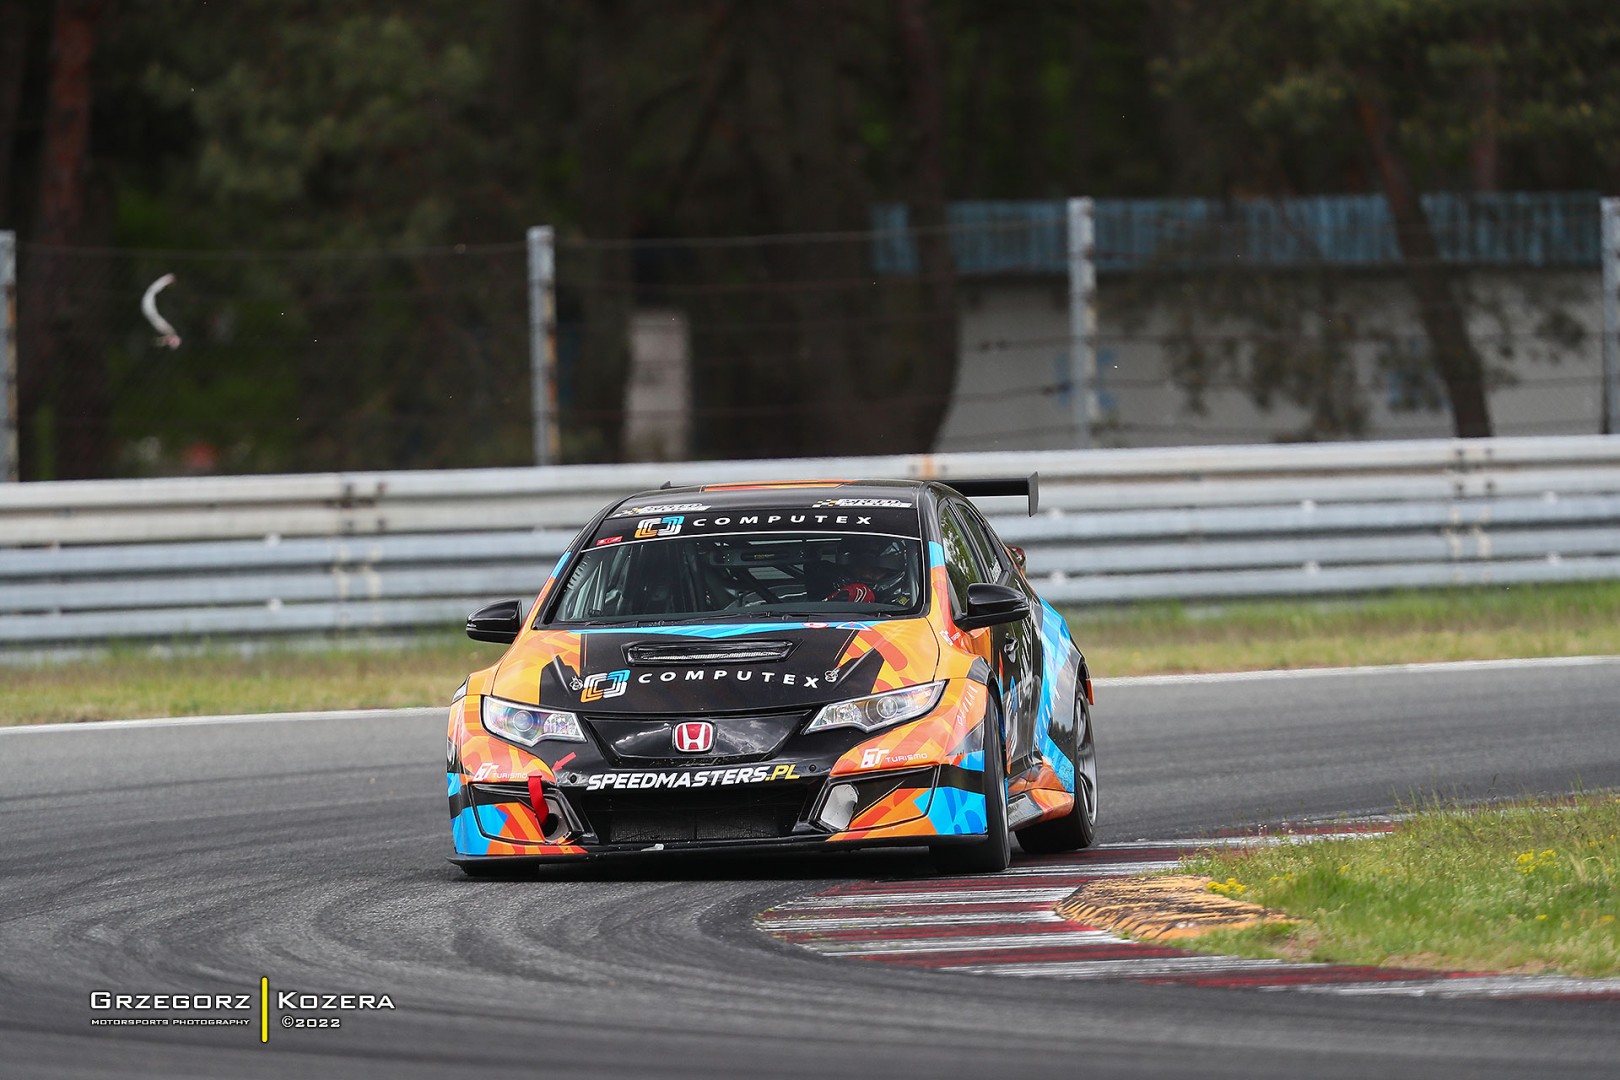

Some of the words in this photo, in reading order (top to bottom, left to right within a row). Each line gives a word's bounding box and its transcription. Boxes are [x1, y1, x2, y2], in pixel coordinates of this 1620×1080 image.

[692, 514, 872, 527] COMPUTEX
[638, 669, 820, 689] COMPUTEX
[885, 753, 928, 763] TURISMO
[586, 764, 801, 791] SPEEDMASTERS.PL
